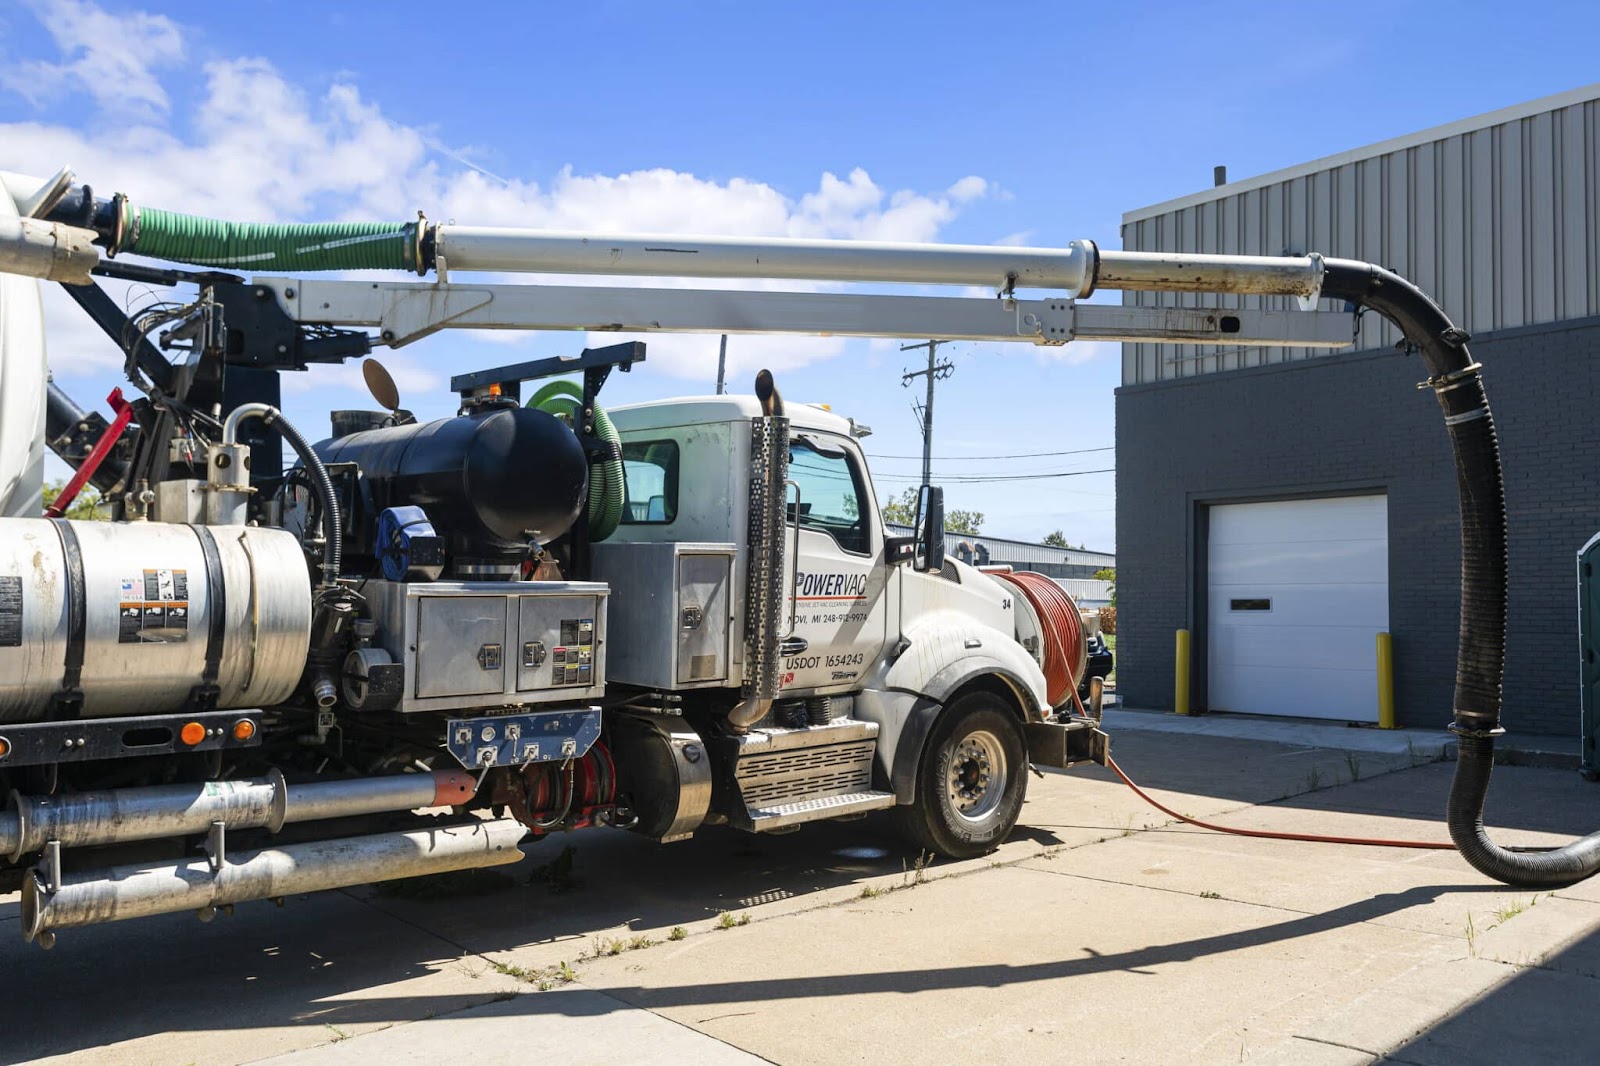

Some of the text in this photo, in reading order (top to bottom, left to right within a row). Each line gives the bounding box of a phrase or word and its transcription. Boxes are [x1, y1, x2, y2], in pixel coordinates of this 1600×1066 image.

[796, 572, 867, 596] POWERVAC
[1002, 599, 1011, 610] 34
[811, 614, 821, 624] MI
[823, 613, 868, 623] 248-912-9974
[786, 653, 864, 670] USDOT 1654243
